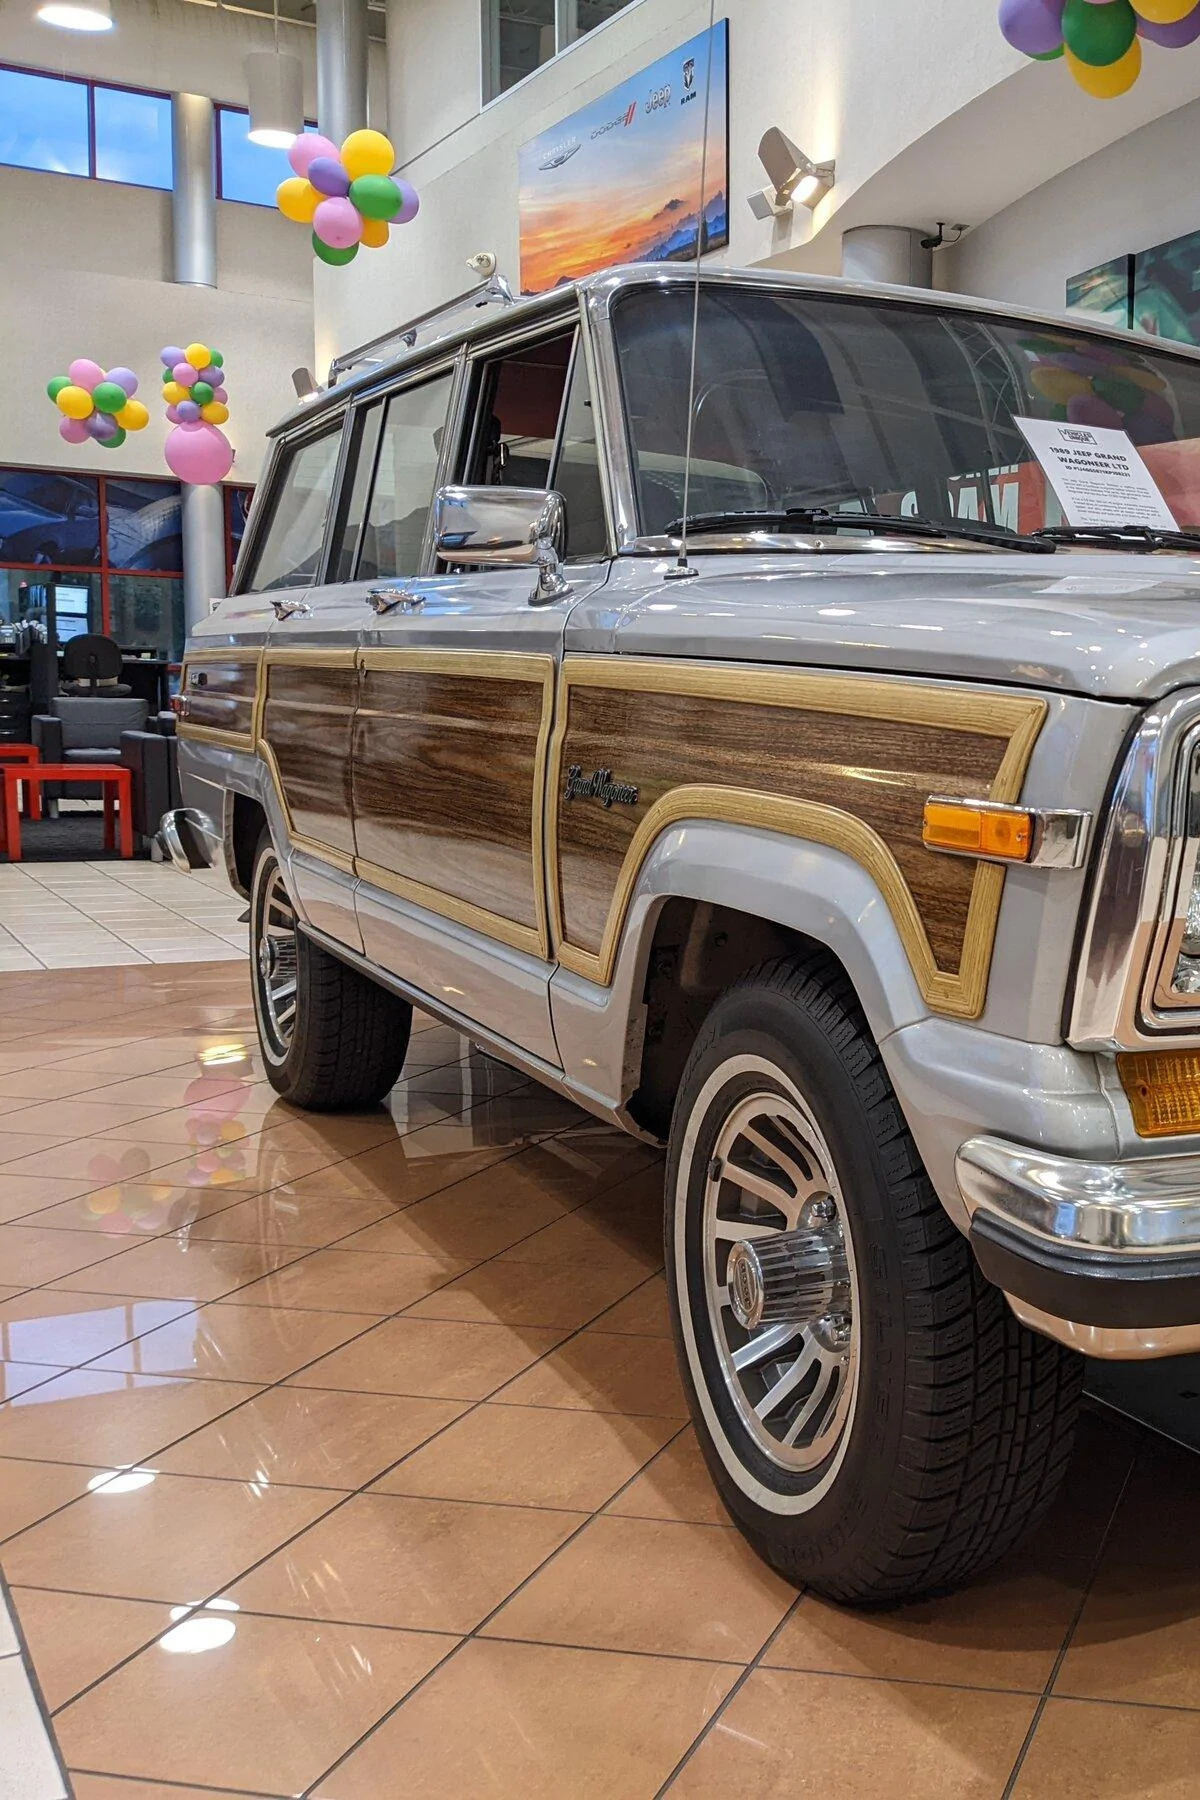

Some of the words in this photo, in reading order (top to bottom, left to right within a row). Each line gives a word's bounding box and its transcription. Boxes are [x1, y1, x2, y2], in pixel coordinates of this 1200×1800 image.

[645, 84, 671, 114] Jeep
[680, 91, 697, 105] RAM
[542, 136, 577, 160] CHRYSLER
[1049, 446, 1071, 455] 1989
[1072, 449, 1092, 457] JEEP
[1094, 452, 1127, 462] GRAND
[1057, 456, 1111, 468] WAGONEER
[1111, 463, 1130, 471] LTD
